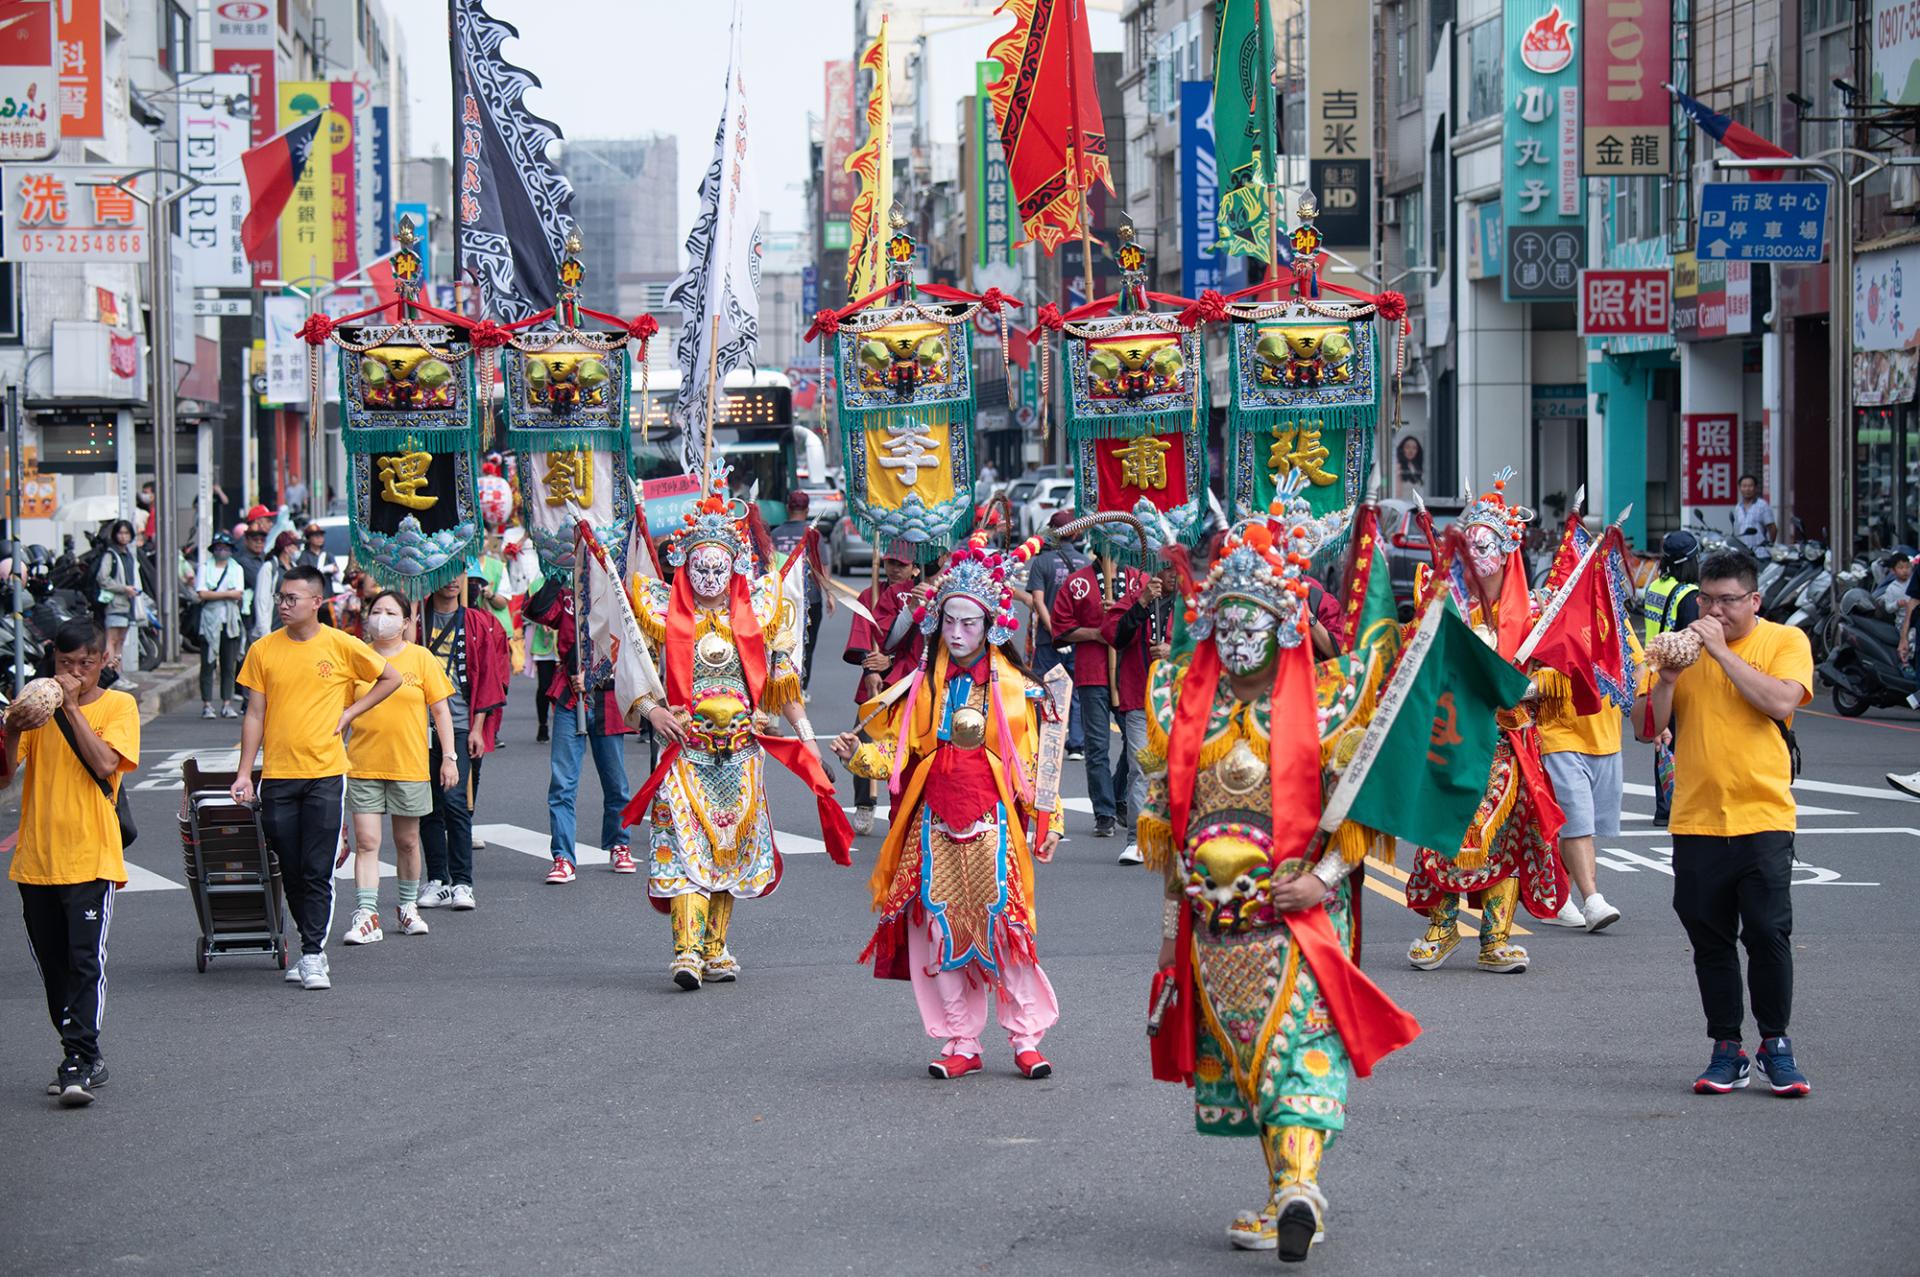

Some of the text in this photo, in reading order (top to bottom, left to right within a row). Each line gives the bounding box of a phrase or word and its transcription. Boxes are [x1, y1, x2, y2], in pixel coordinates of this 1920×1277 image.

[1515, 85, 1553, 213] 小丸子
[1595, 135, 1659, 166] 金龍
[1324, 188, 1357, 208] HD
[1732, 192, 1821, 212] 市政中心
[22, 235, 142, 254] 05-2254868
[1728, 221, 1818, 240] 停車場
[1741, 244, 1817, 258] 直行300公尺
[1588, 278, 1667, 328] 照相
[1675, 308, 1697, 329] SONY
[1698, 302, 1726, 329] Canon
[878, 414, 941, 486] 李
[1268, 419, 1339, 487] 張
[1696, 420, 1731, 500] 照相
[377, 436, 439, 510] 連
[542, 442, 594, 510] 劉
